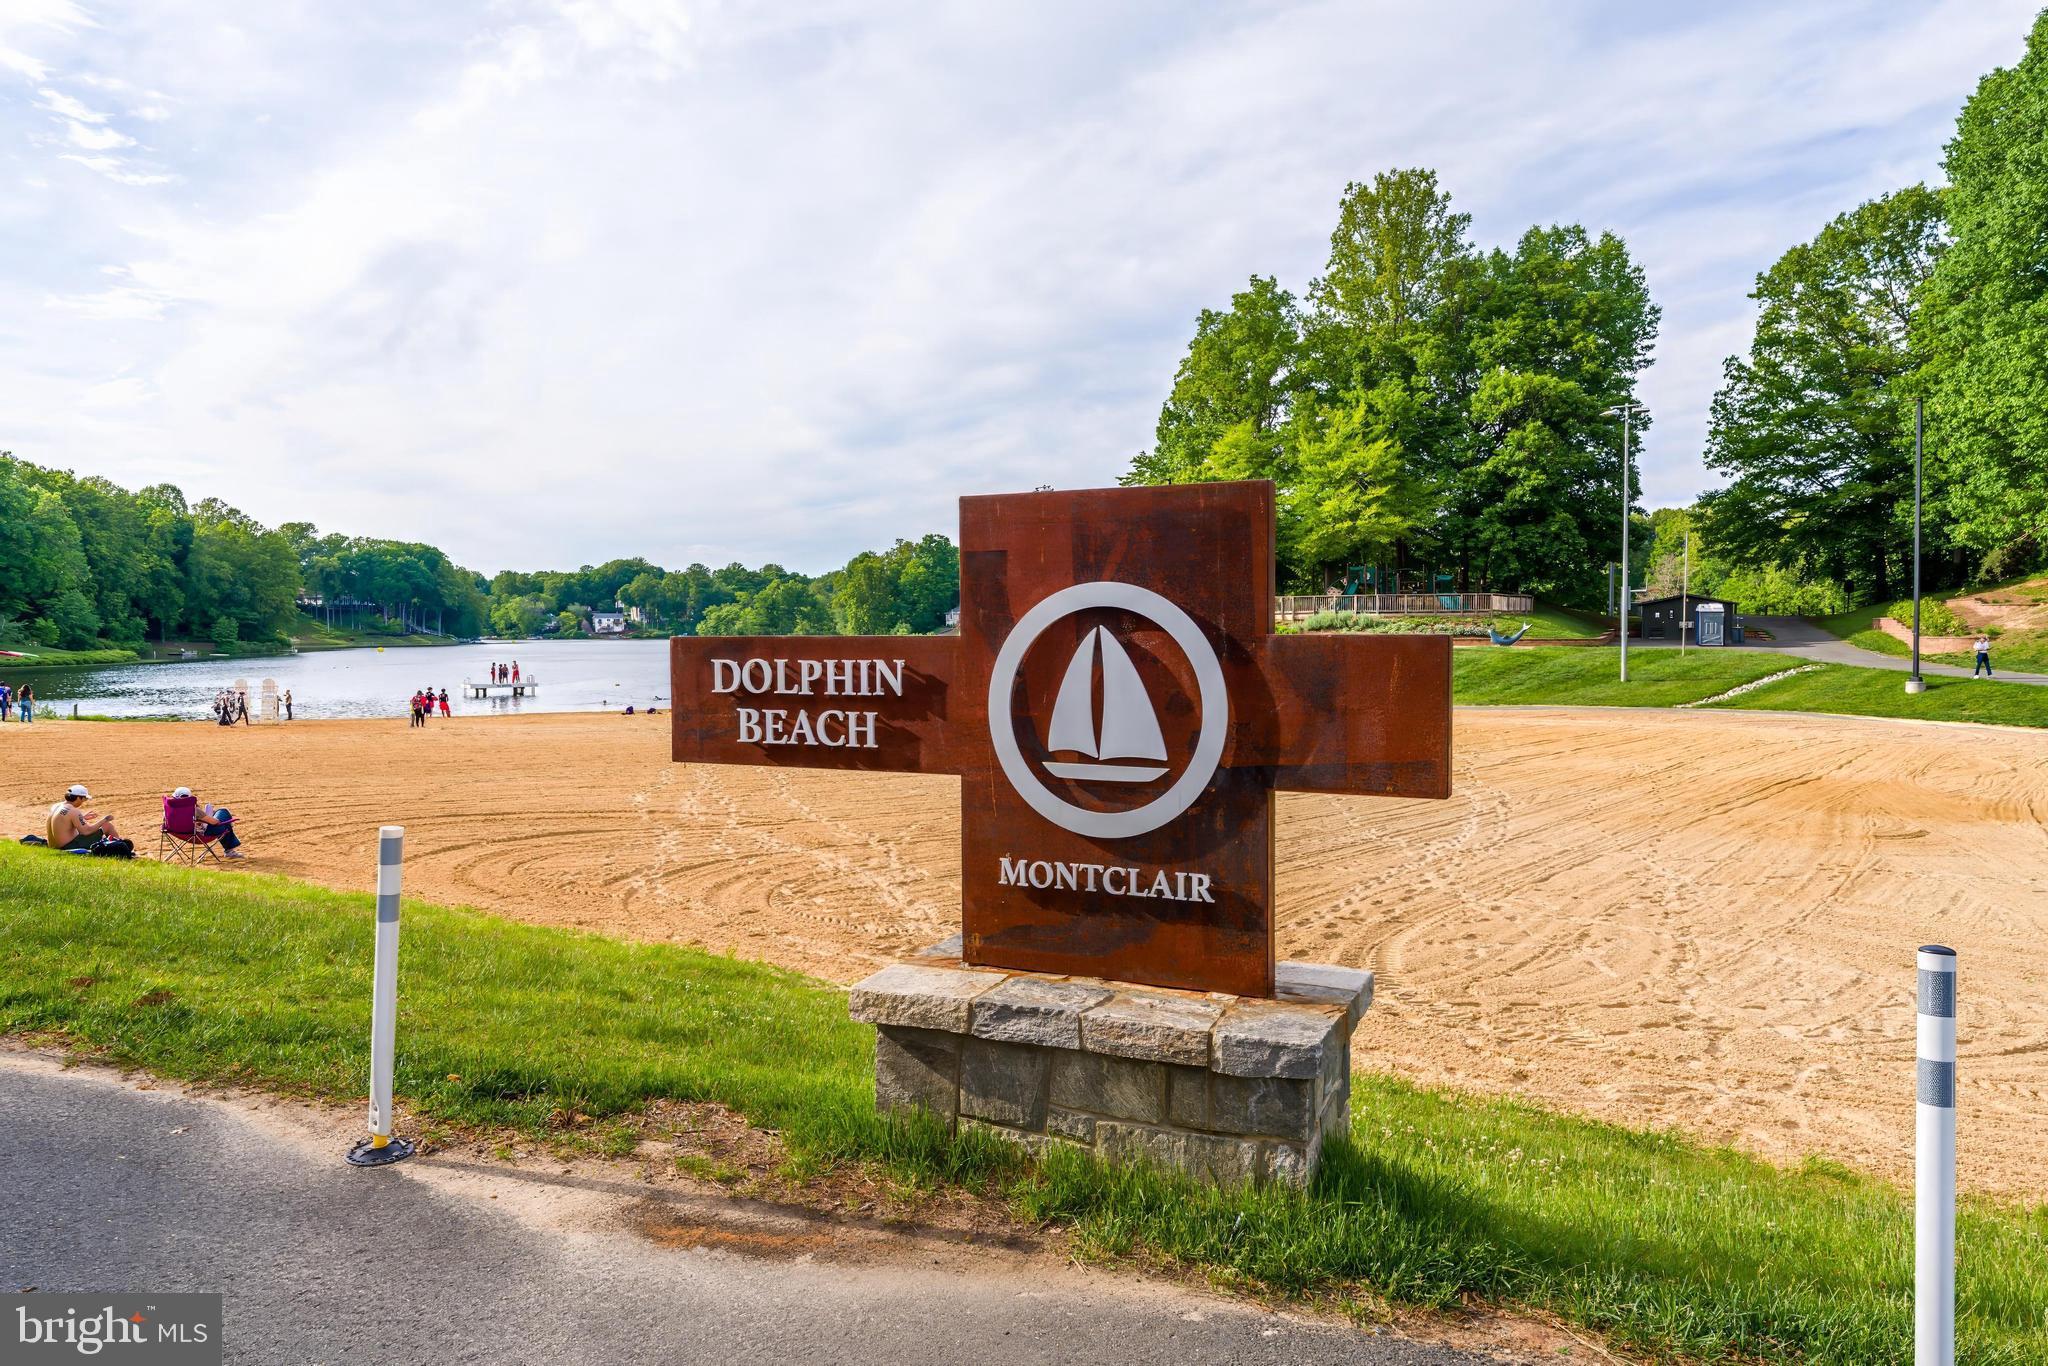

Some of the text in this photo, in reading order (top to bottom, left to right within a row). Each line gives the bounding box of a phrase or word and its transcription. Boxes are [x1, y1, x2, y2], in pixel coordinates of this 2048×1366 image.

[710, 658, 905, 697] DOLPHIN
[736, 707, 879, 748] BEACH
[998, 857, 1215, 904] MONTCLAIR
